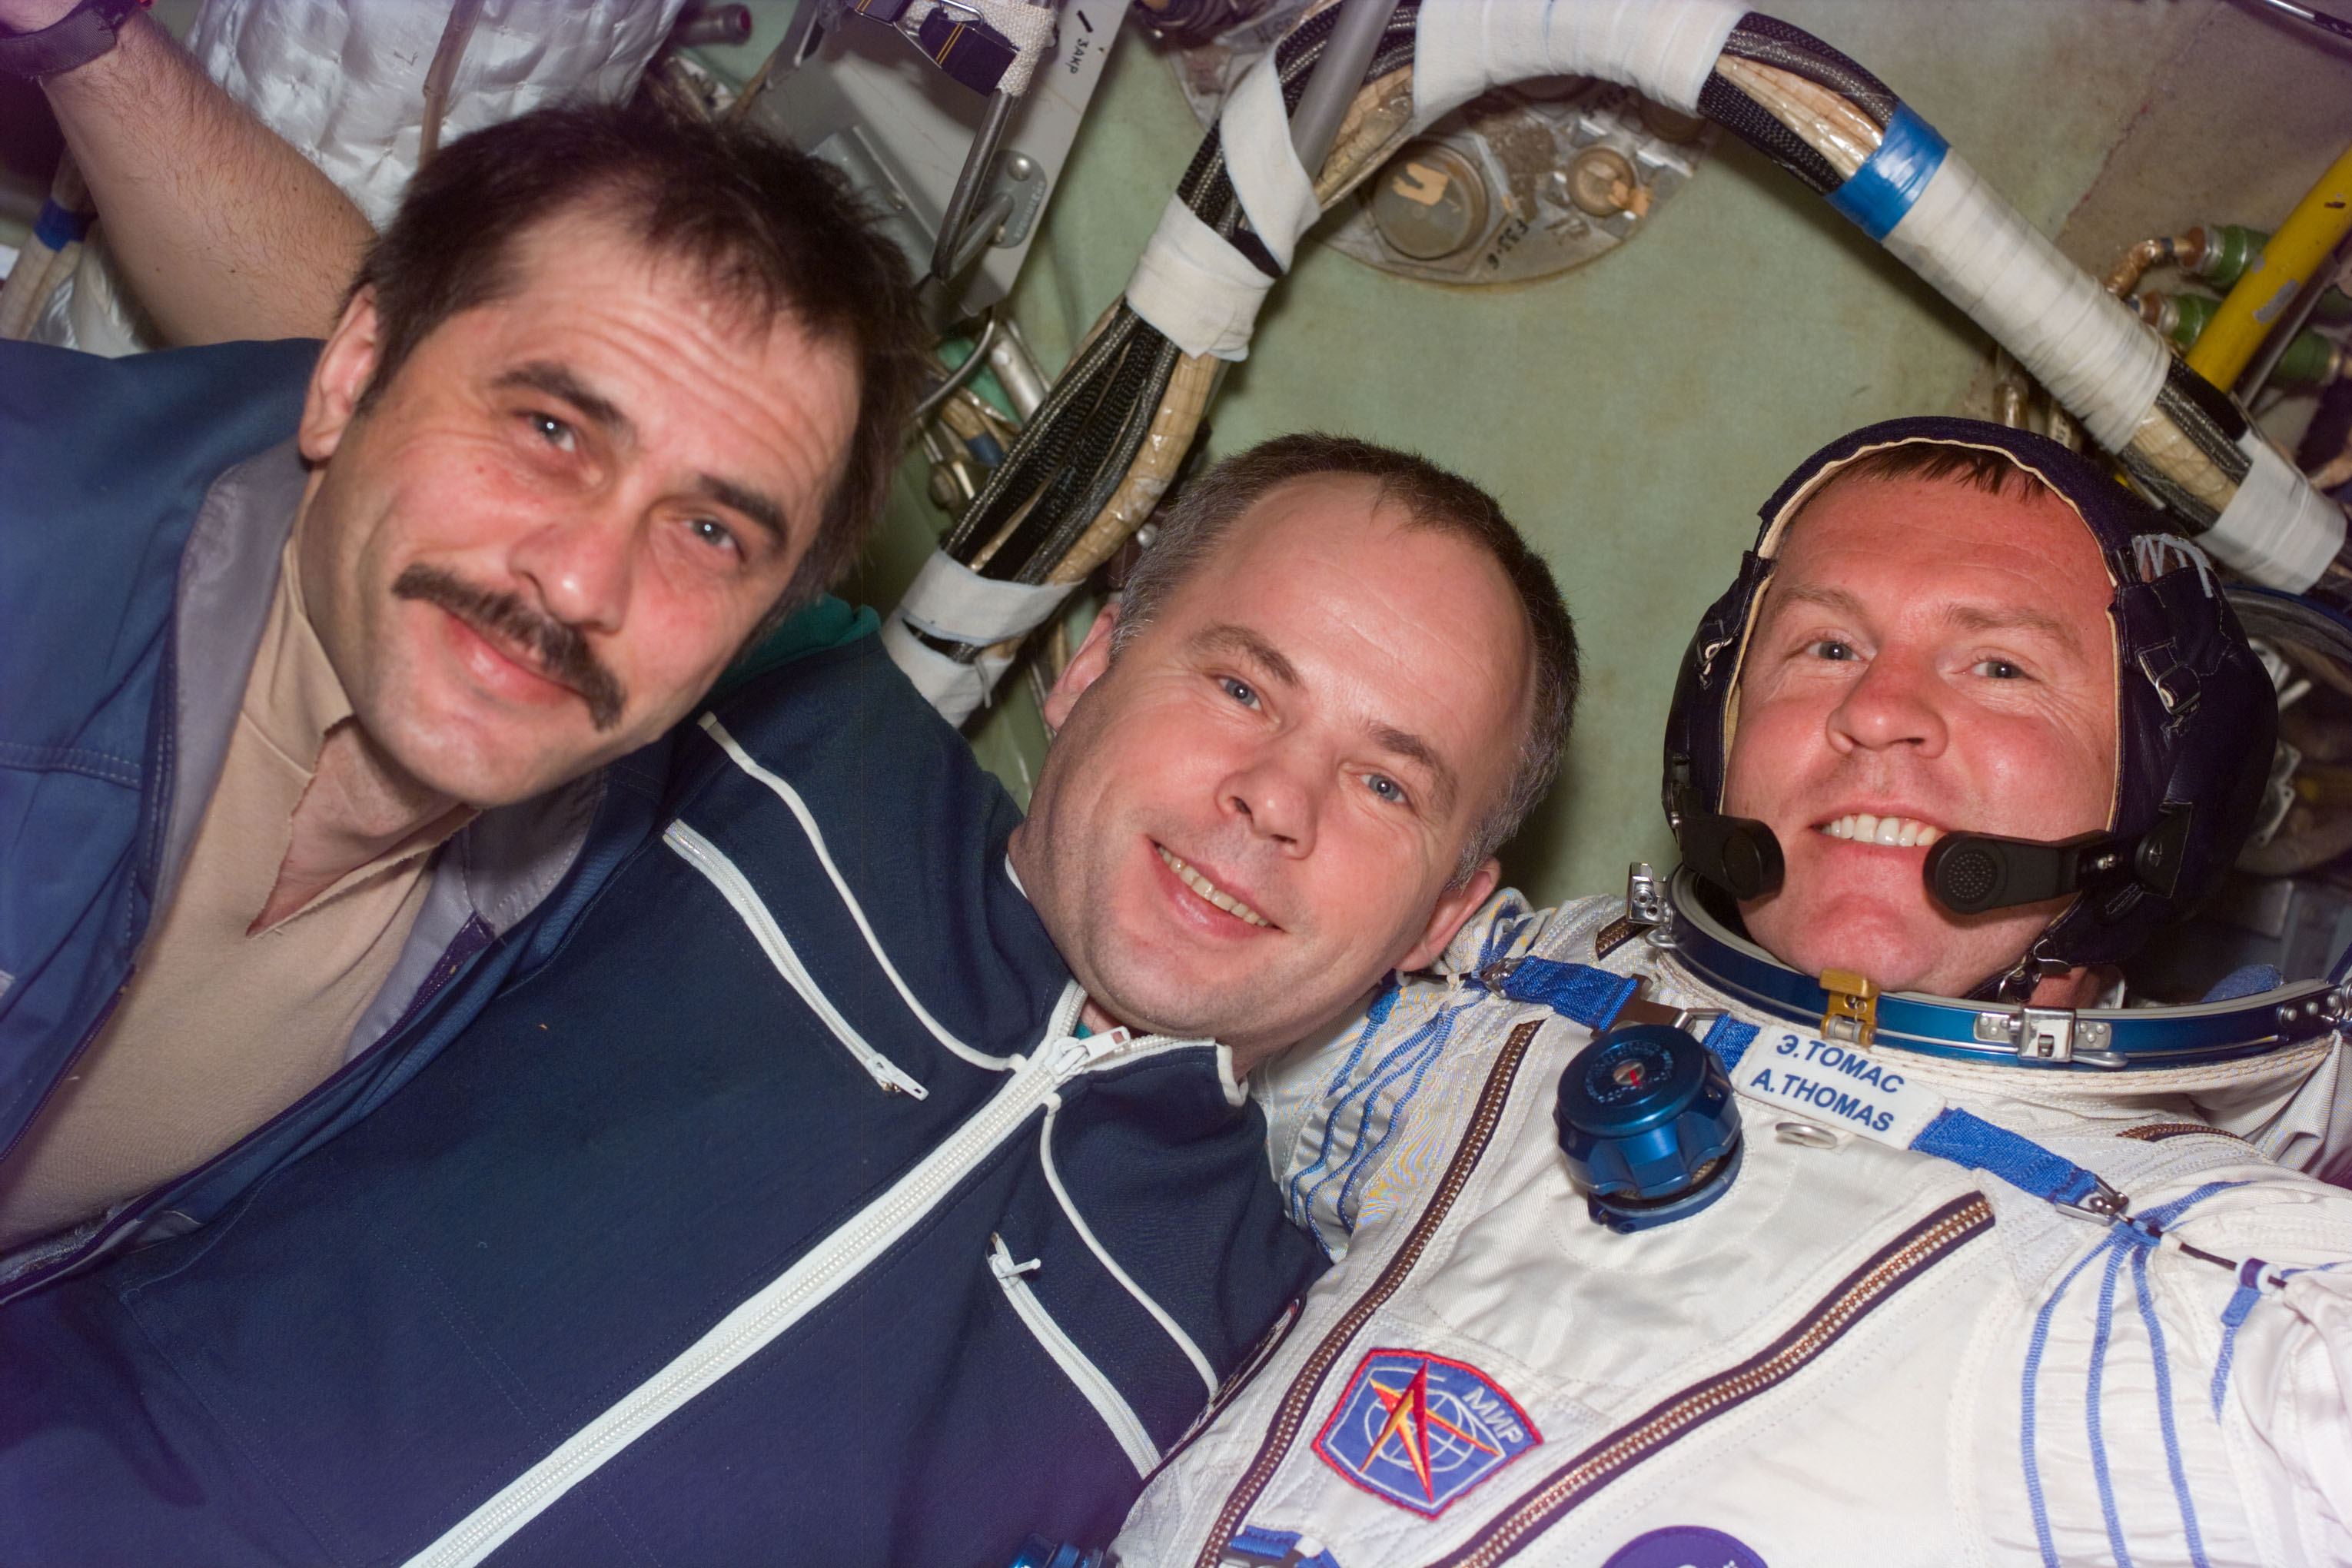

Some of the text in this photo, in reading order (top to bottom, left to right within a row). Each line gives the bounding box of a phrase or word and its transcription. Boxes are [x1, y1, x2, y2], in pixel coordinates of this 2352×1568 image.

[1776, 1034, 1905, 1093] Э.ТОМАС
[1749, 1068, 1895, 1131] A.THOMAS
[1462, 1386, 1524, 1443] МИР
